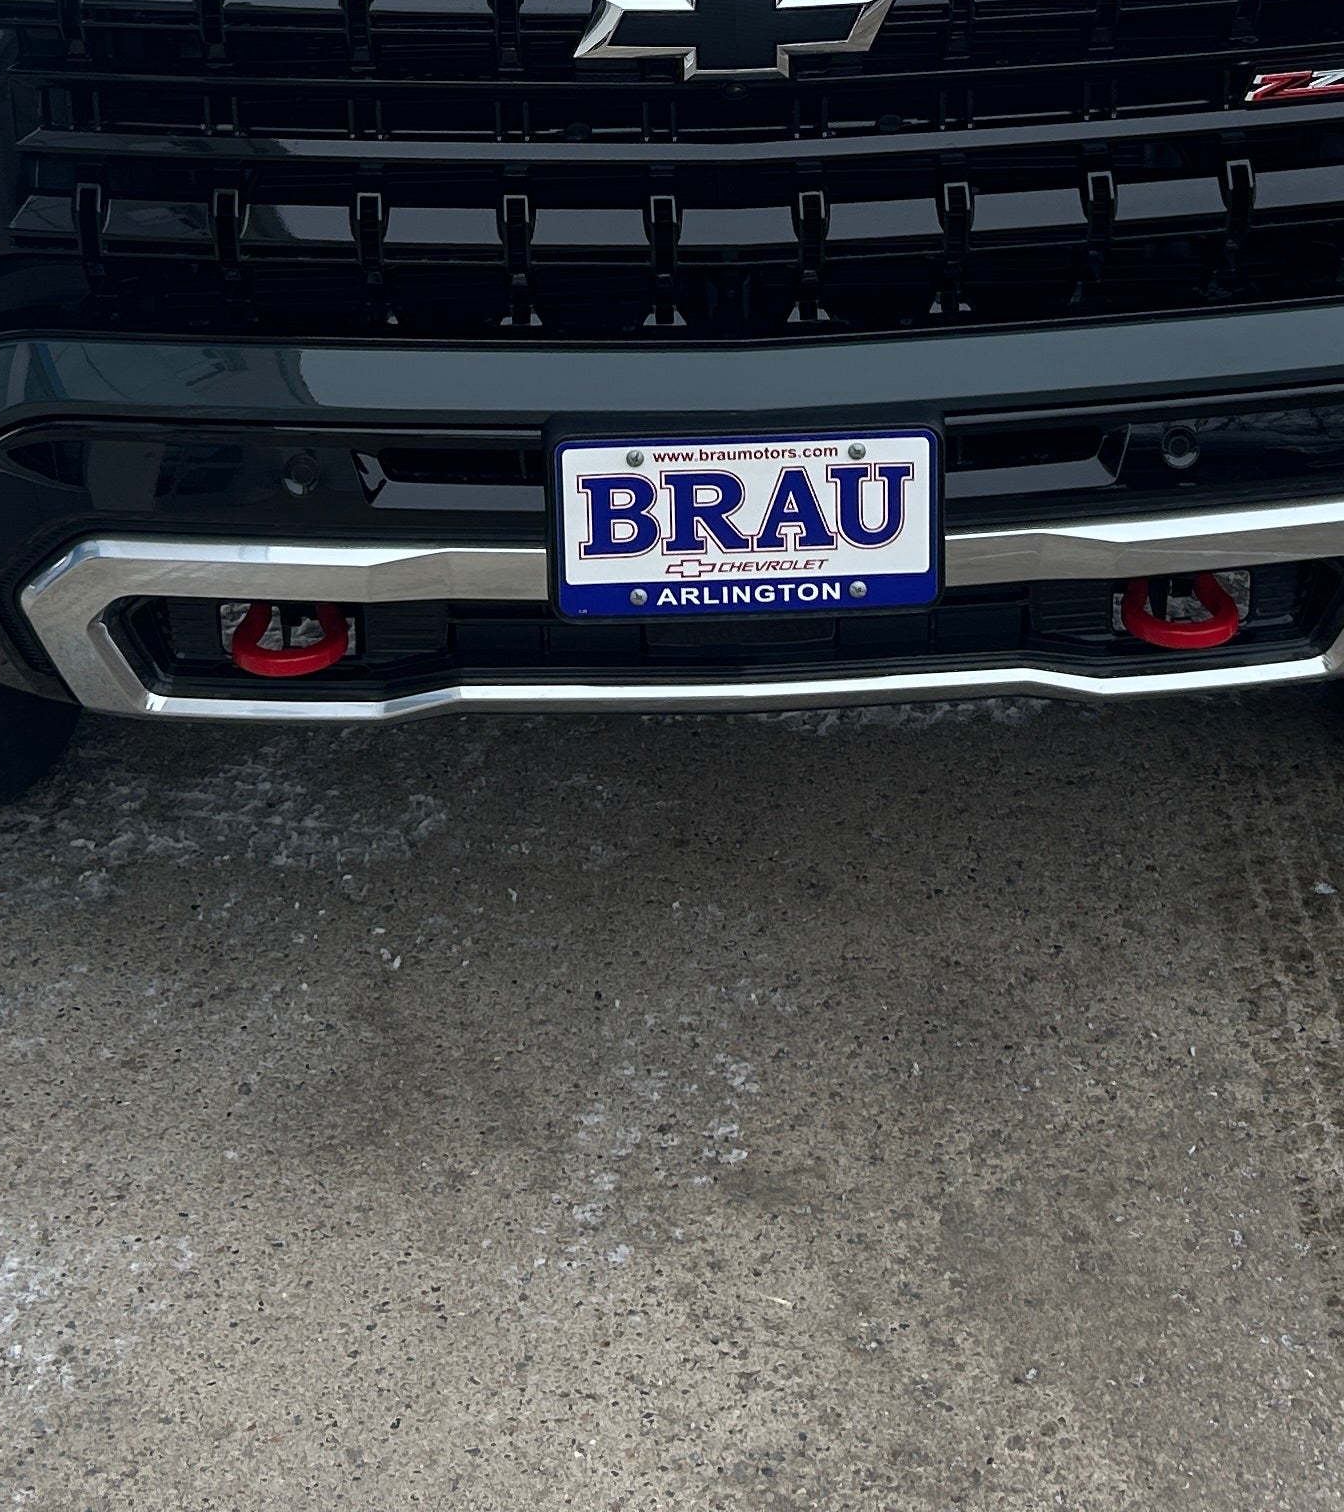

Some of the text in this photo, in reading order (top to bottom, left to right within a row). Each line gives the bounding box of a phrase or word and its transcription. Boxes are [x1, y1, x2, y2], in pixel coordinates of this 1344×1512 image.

[652, 446, 838, 463] www.braumotors.com
[576, 461, 915, 561] BRAU
[718, 559, 829, 573] CHEVROLET
[656, 582, 841, 606] ARLINGTON
